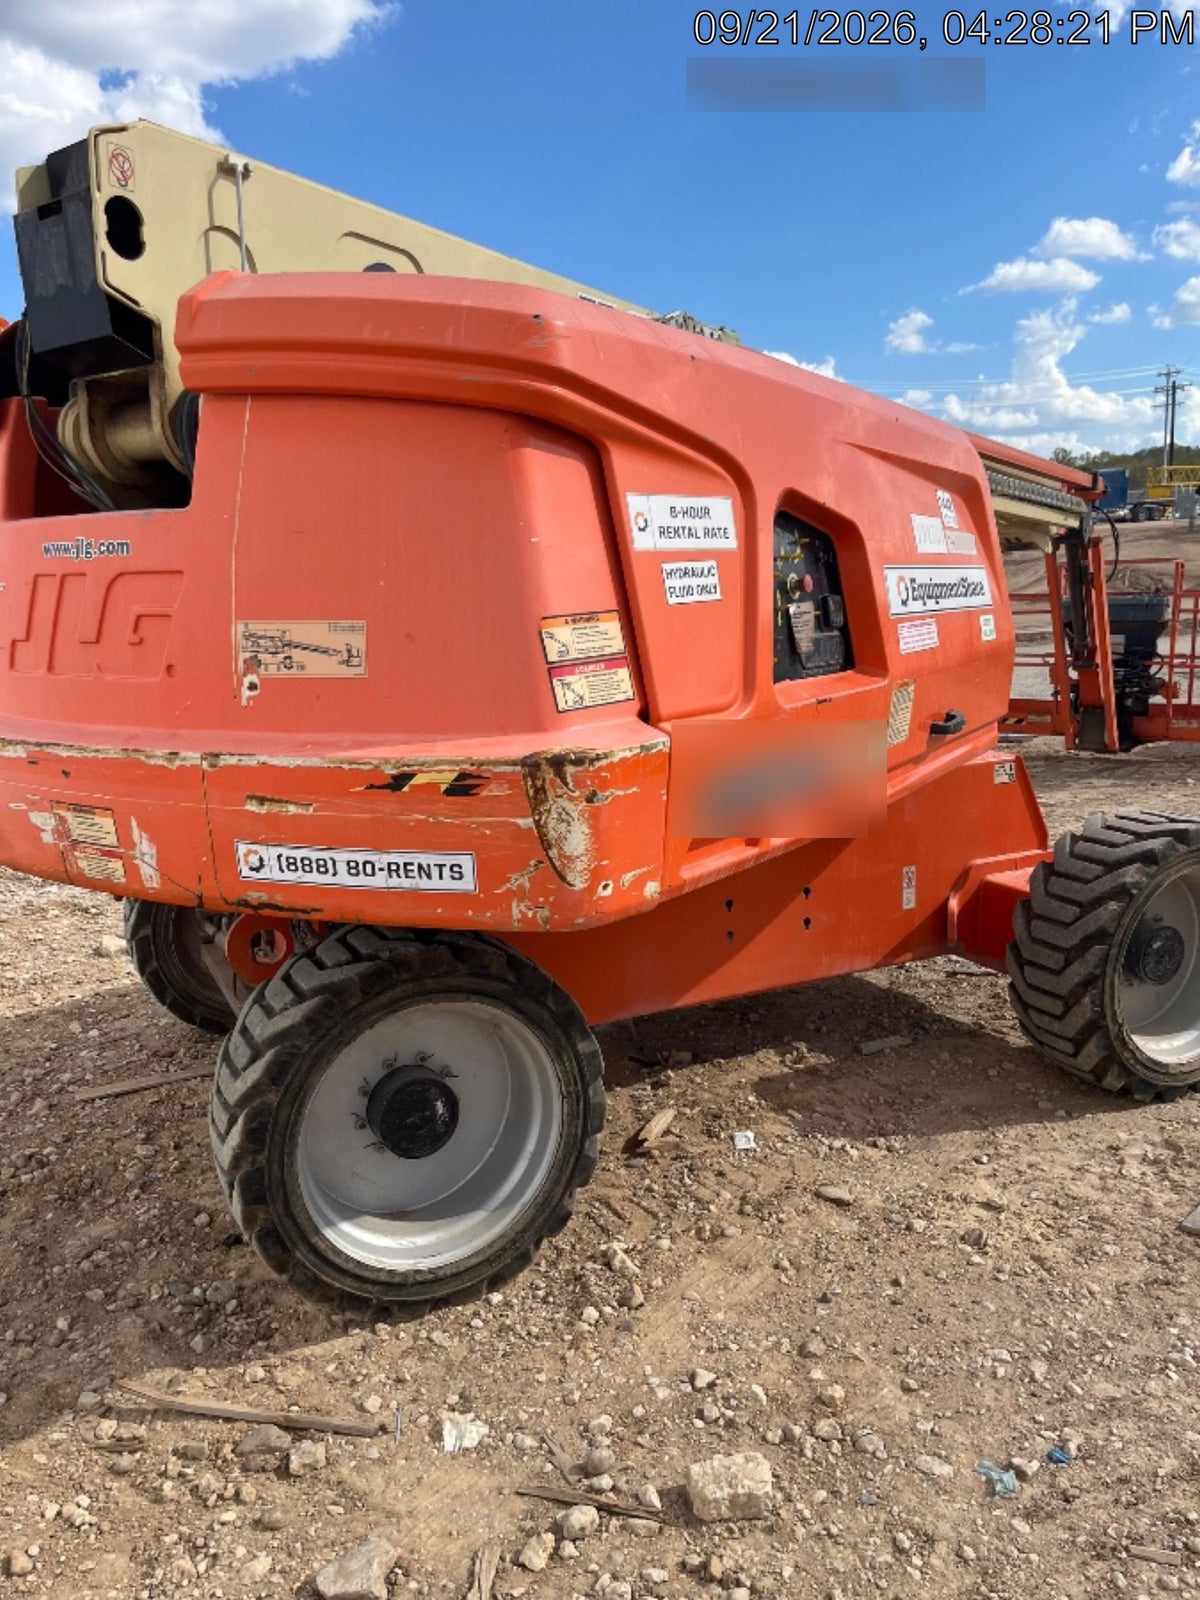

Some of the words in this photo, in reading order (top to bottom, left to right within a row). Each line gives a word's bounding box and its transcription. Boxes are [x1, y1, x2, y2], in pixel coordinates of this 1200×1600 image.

[659, 526, 701, 539] RENTAL
[703, 527, 730, 540] RATE
[43, 537, 130, 560] www.jlg.com
[9, 569, 186, 682] JLG
[276, 853, 338, 877] (888)
[346, 860, 465, 881] 80-RENTS
